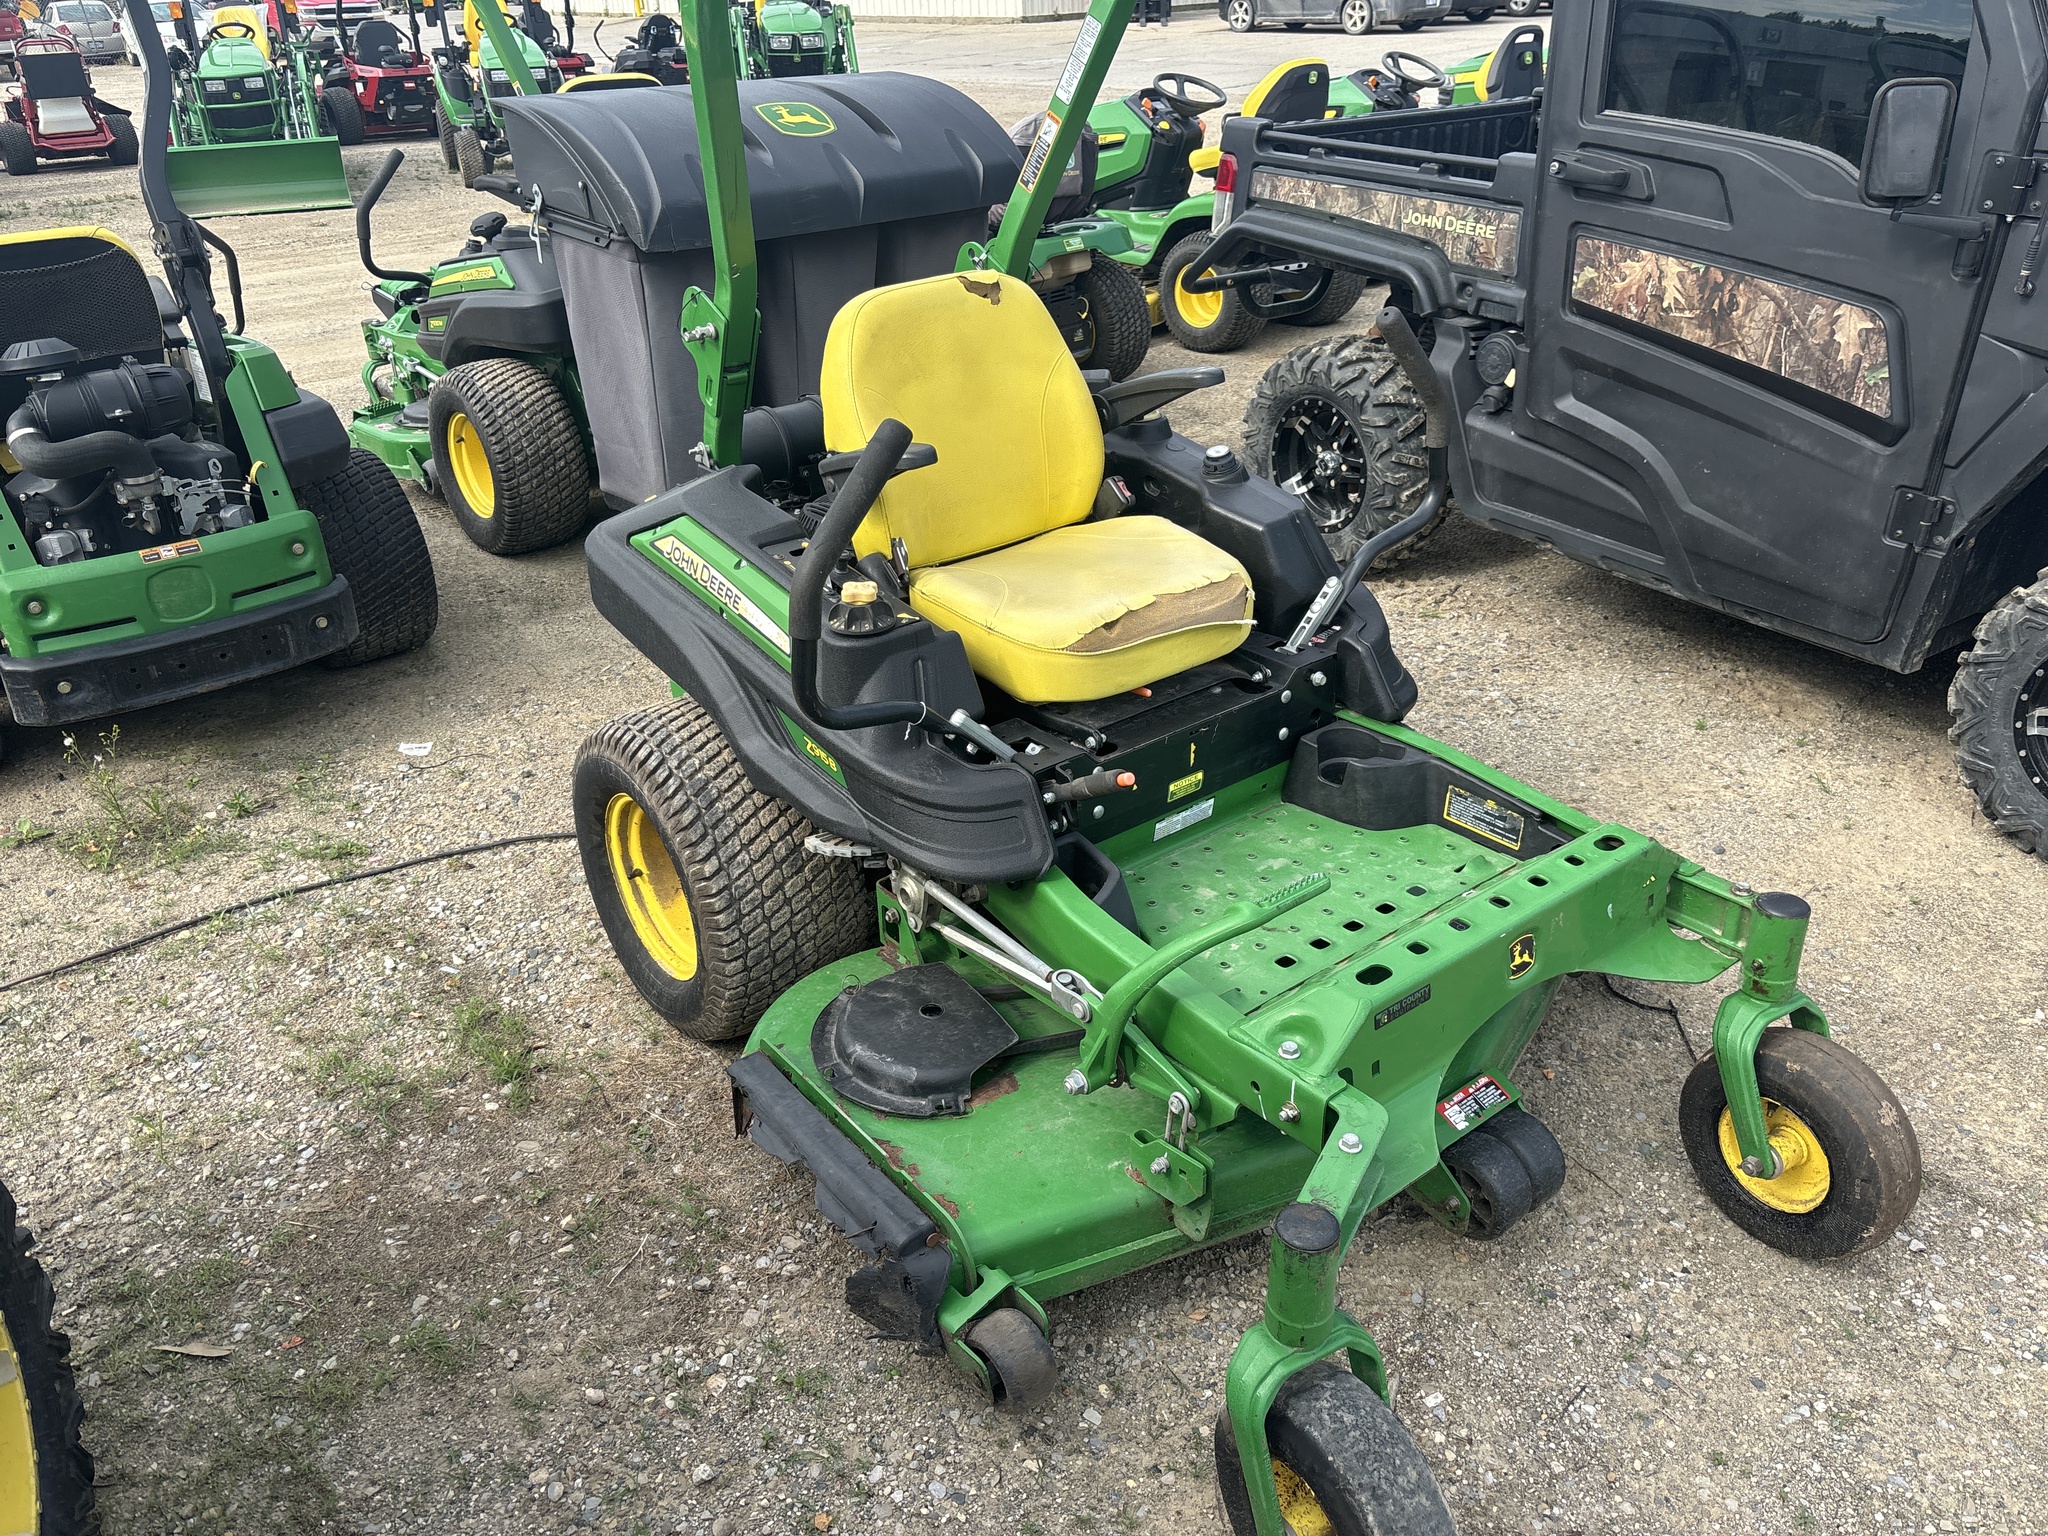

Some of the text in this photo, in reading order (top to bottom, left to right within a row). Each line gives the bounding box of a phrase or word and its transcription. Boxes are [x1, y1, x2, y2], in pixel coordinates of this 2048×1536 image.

[1402, 209, 1497, 239] JOHN DEERE
[665, 540, 742, 612] JOHN DEERE
[1173, 774, 1199, 789] NOTICE
[1388, 985, 1430, 1014] TRI COUNTY
[1390, 994, 1430, 1021] EQUIPMENT
